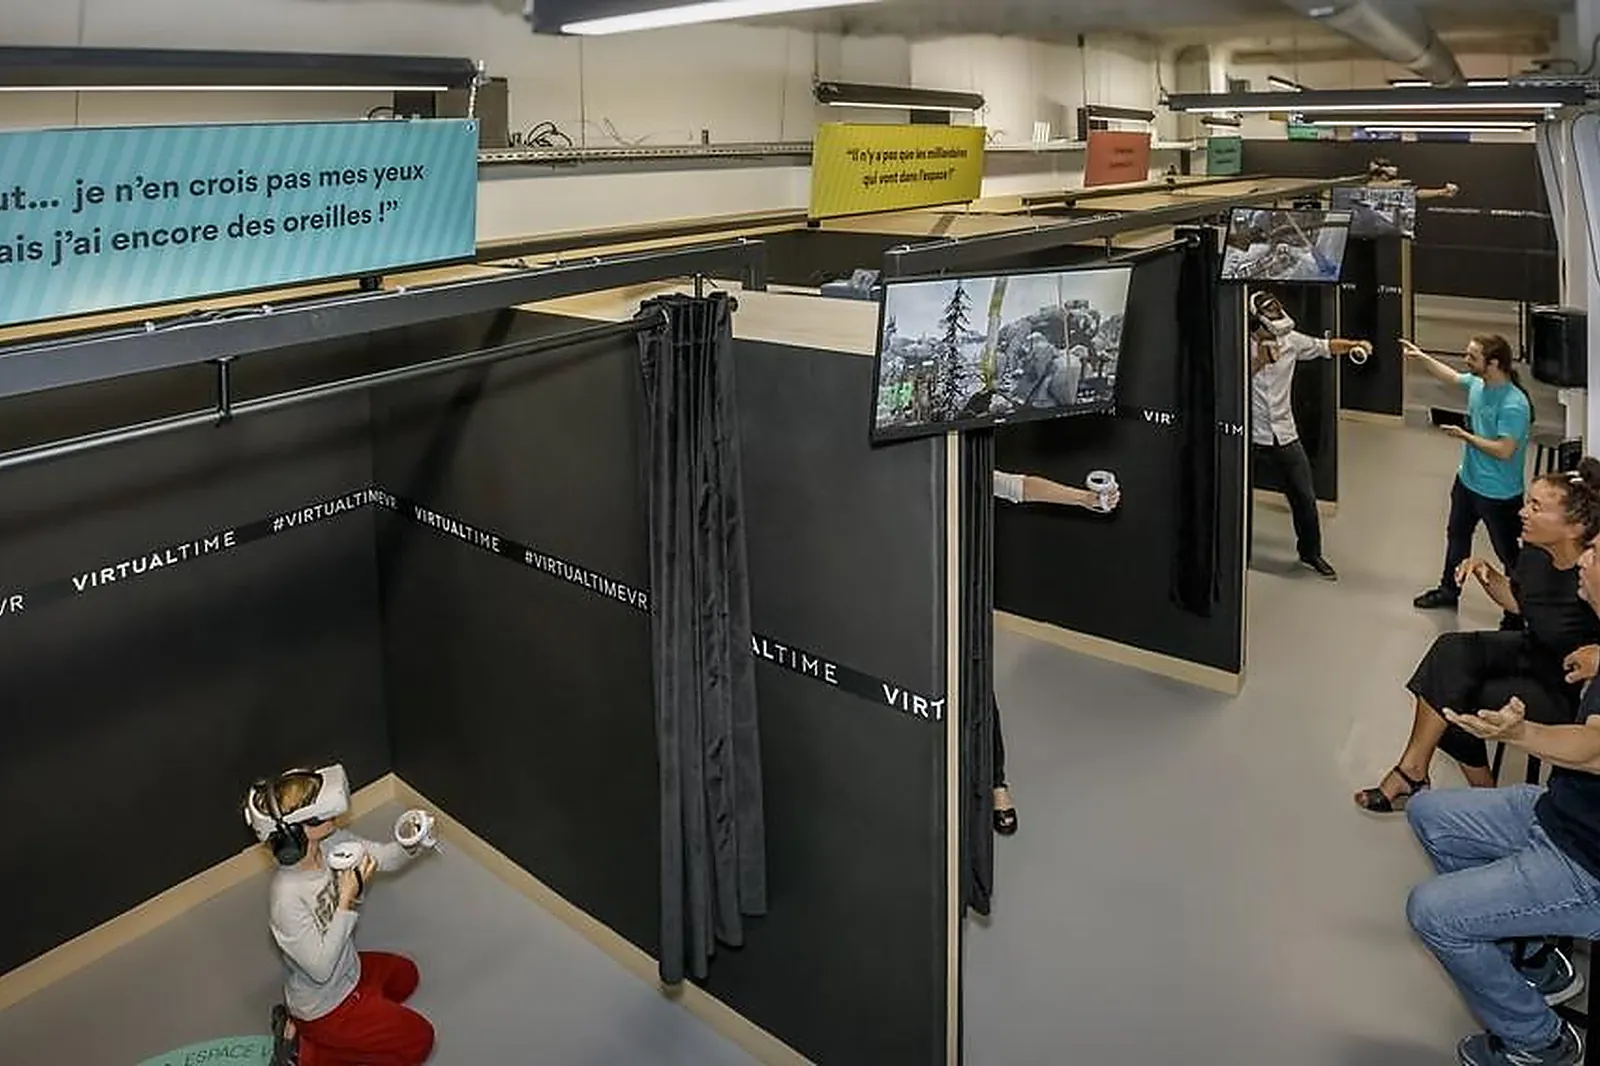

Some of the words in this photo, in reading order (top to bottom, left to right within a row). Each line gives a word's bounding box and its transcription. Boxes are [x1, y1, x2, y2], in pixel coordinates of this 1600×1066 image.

[71, 178, 106, 214] je
[116, 176, 179, 203] n’en
[189, 169, 258, 197] crois
[266, 172, 312, 198] pas
[319, 168, 368, 187] mes
[373, 164, 425, 190] yeux
[863, 170, 877, 189] qui
[879, 172, 898, 184] vont
[51, 227, 101, 267] j’ai
[112, 223, 218, 251] encore
[227, 213, 275, 239] des
[283, 203, 372, 233] oreilles
[1143, 410, 1176, 425] VIR
[72, 530, 236, 592] VIRTUALTIME
[414, 504, 501, 553] VIRTUALTIME
[525, 549, 649, 610] #VIRTUALTIMEVR
[882, 682, 946, 720] VIRT
